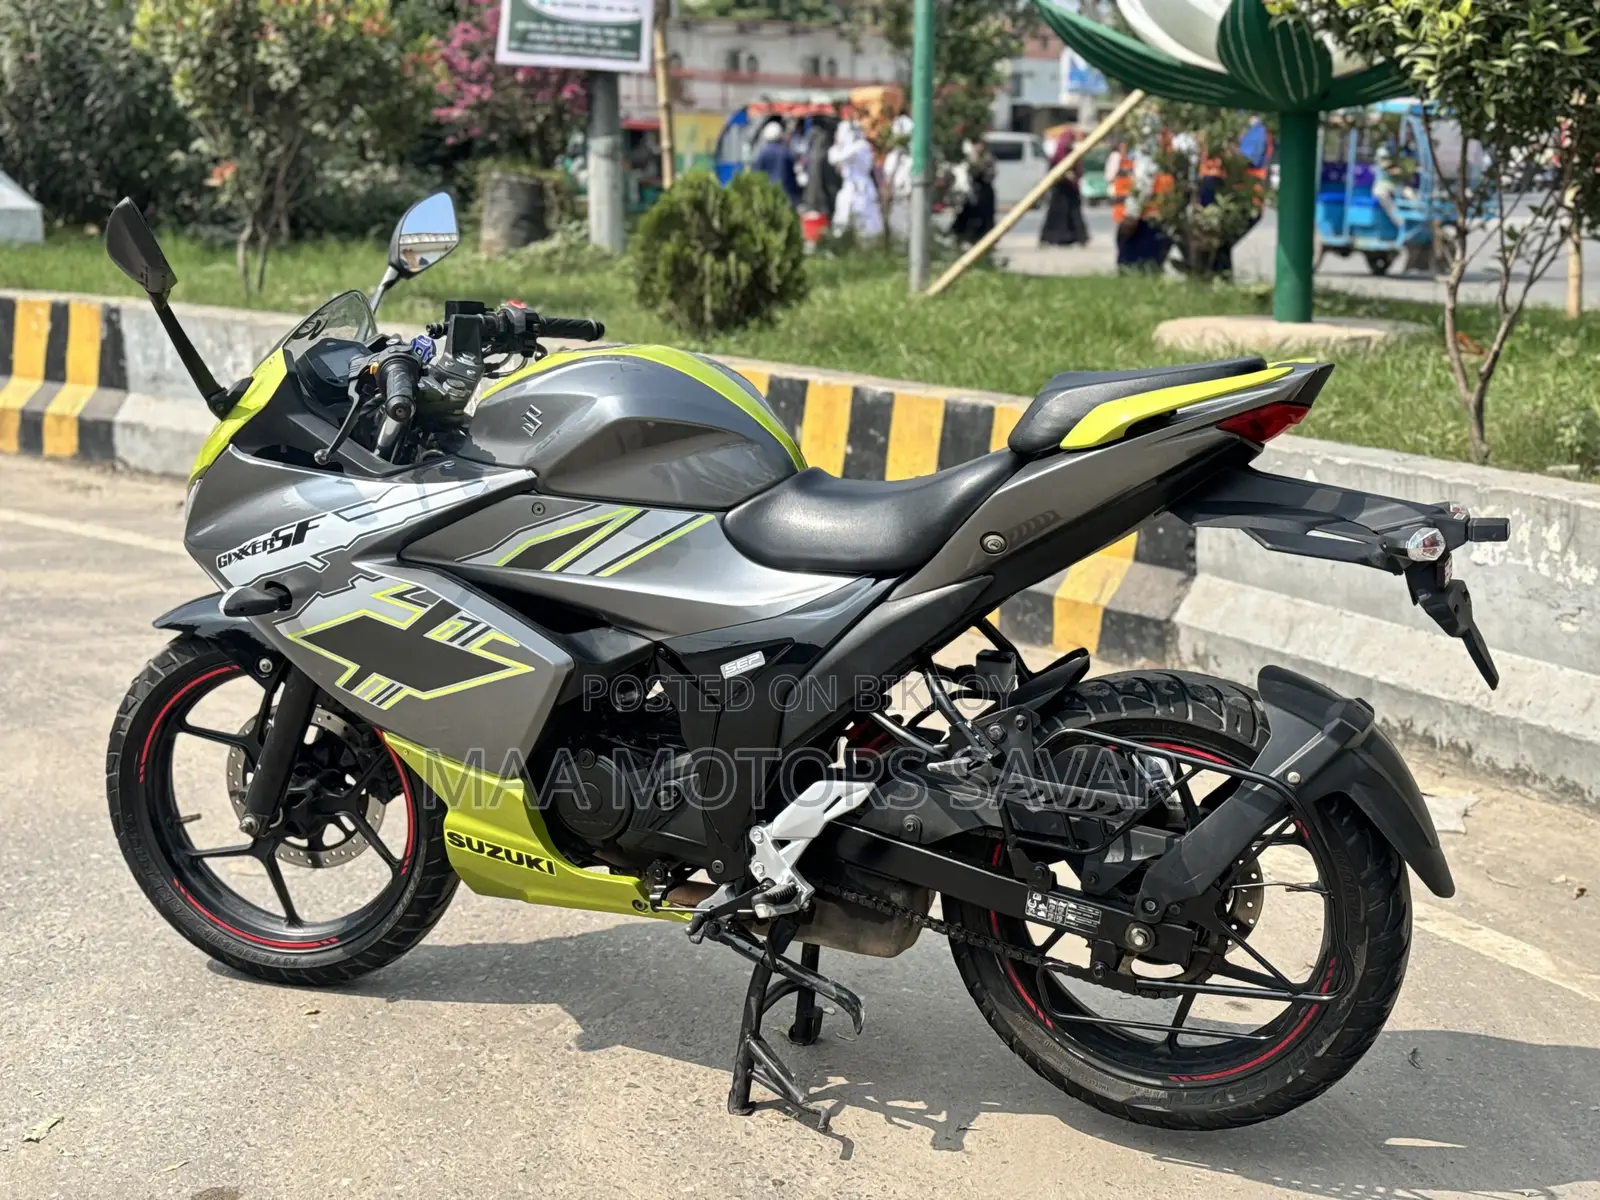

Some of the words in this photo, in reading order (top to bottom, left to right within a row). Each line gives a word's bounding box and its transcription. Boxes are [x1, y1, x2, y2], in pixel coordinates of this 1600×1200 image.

[217, 536, 275, 569] GIXXER
[266, 513, 328, 555] SF
[446, 831, 555, 875] SUZUKI
